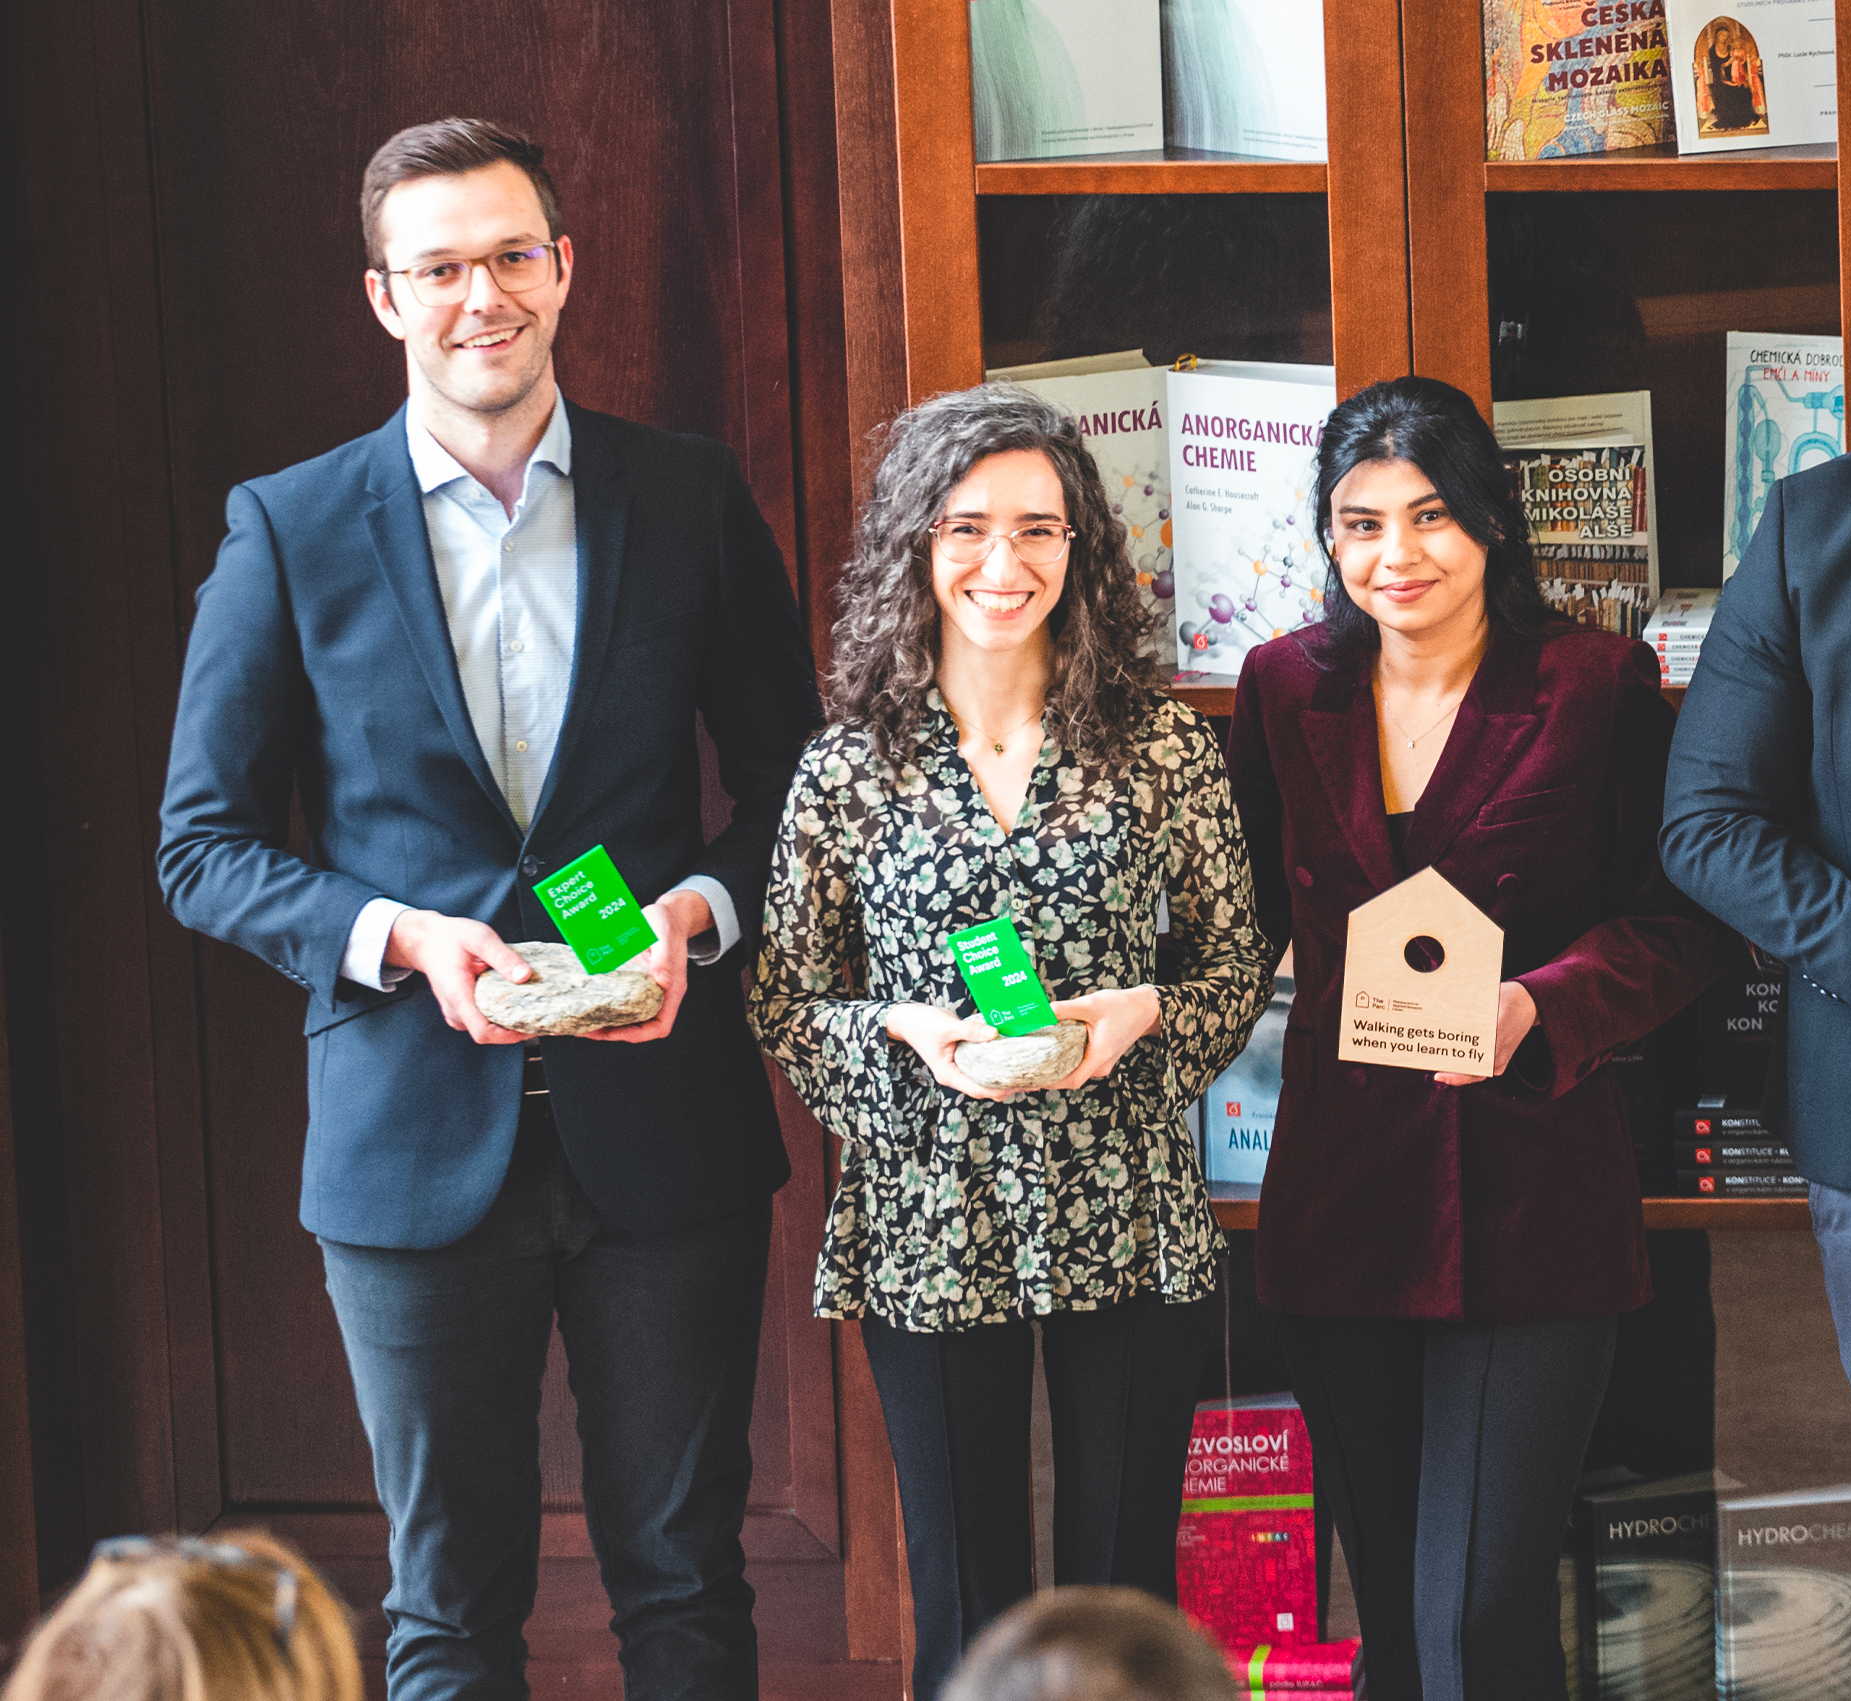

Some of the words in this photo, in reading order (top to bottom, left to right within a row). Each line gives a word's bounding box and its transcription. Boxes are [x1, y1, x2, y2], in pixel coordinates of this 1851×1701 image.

[1531, 23, 1667, 64] SKLENĚNÁ
[1548, 59, 1669, 93] MOZAIKA
[1564, 111, 1596, 122] CZECH
[1598, 107, 1629, 119] GLASS
[1631, 101, 1670, 113] MOZAIC
[1750, 348, 1802, 365] CHEMICKÁ
[1791, 369, 1800, 381] A
[1803, 368, 1831, 383] MÍNY
[1182, 444, 1257, 473] CHEMIE
[1548, 467, 1631, 483] OSOBNÍ
[1185, 484, 1216, 498] Catherine
[1217, 489, 1224, 498] E.
[1225, 489, 1260, 501] Housecroft
[1521, 486, 1632, 502] KNIHOVNA
[1186, 501, 1201, 511] Alan
[1210, 503, 1233, 516] Sharpe
[1523, 502, 1633, 522] MIKOLÁŠE
[1580, 520, 1633, 539] ALŠE
[546, 870, 586, 899] Expert
[554, 881, 594, 909] Choice
[561, 891, 598, 920] Award
[598, 897, 627, 920] 2024
[956, 931, 998, 952] Student
[962, 945, 1000, 963] Choice
[969, 956, 1002, 976] Award
[1001, 970, 1028, 987] 2024
[1745, 983, 1781, 997] KON
[1353, 1019, 1405, 1038] Walking
[1407, 1027, 1435, 1039] gets
[1438, 1029, 1480, 1047] boring
[1726, 1017, 1763, 1031] KON
[1352, 1036, 1387, 1049] when
[1390, 1041, 1414, 1053] you
[1417, 1043, 1449, 1056] learn
[1452, 1048, 1466, 1058] to
[1468, 1048, 1485, 1063] fly
[1722, 1147, 1773, 1156] KONSTITUCE
[1725, 1176, 1776, 1185] KONSTITUCE
